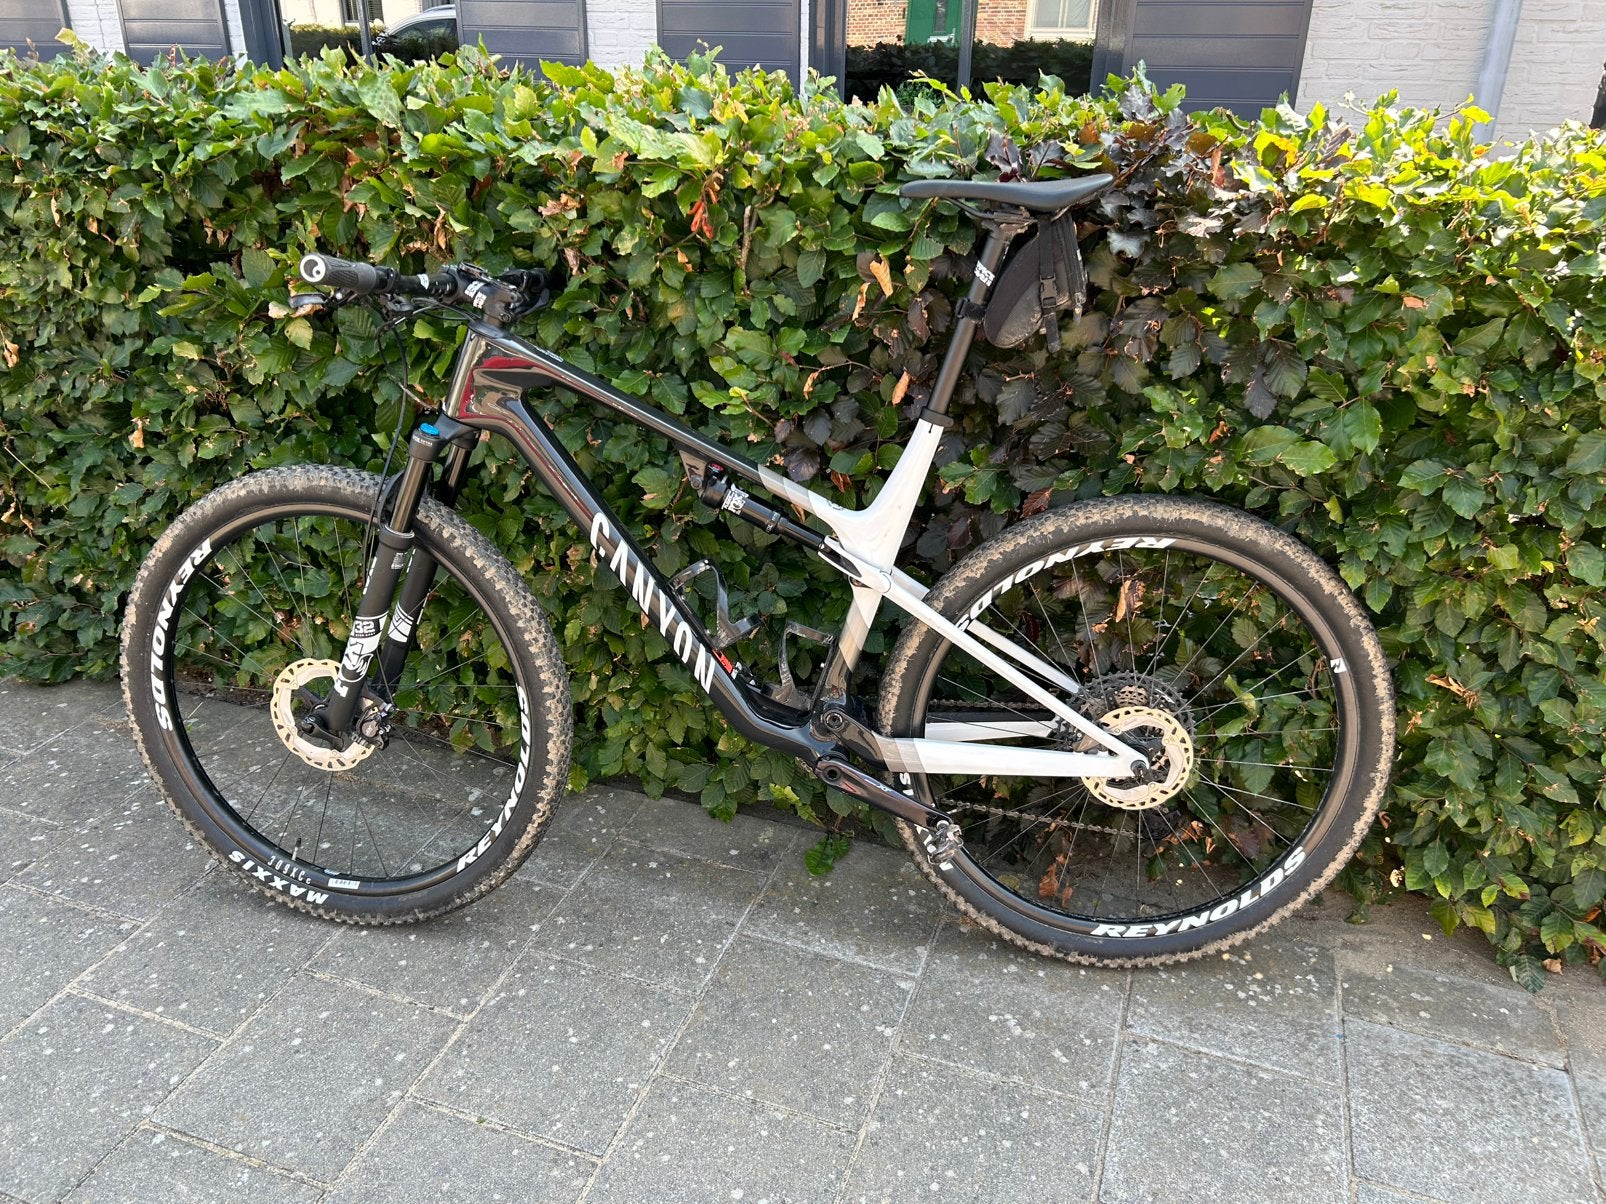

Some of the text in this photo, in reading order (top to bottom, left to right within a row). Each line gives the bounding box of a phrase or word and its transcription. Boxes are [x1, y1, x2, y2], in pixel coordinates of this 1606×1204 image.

[354, 620, 376, 634] 32
[590, 512, 715, 694] CANYON
[955, 536, 1177, 633] REYNOLDS
[151, 538, 212, 732] REYNOLDS
[456, 683, 531, 873] REYNOLDS
[228, 850, 330, 905] MAXXIS
[1090, 846, 1306, 938] REYNOLDS
